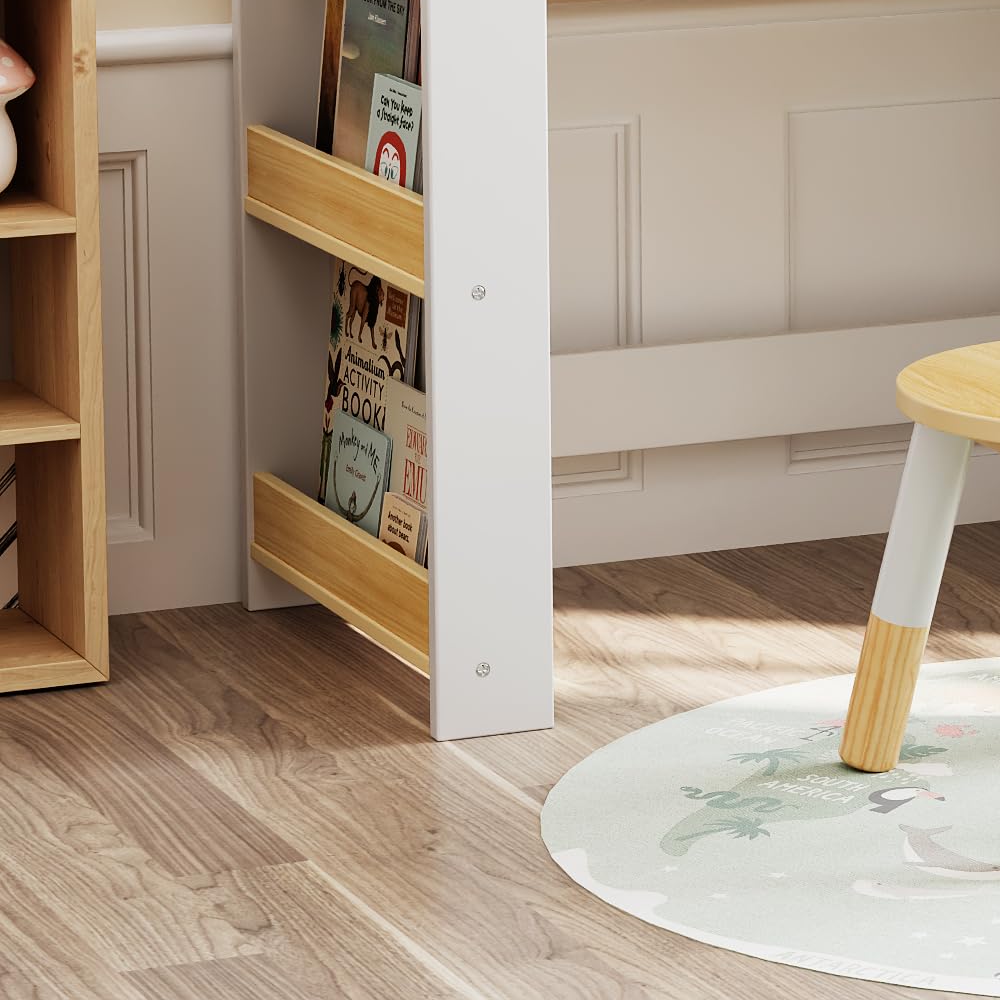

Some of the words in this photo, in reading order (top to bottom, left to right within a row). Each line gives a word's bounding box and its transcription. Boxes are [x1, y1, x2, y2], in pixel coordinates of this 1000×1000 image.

[388, 0, 397, 13] THE
[345, 345, 385, 381] Animalium
[344, 365, 385, 401] ACTIVITY
[403, 458, 427, 504] EMU
[403, 518, 413, 533] book
[757, 780, 855, 804] AMERICA
[797, 774, 871, 792] SOUTH
[776, 951, 936, 985] ANTARCTICA
